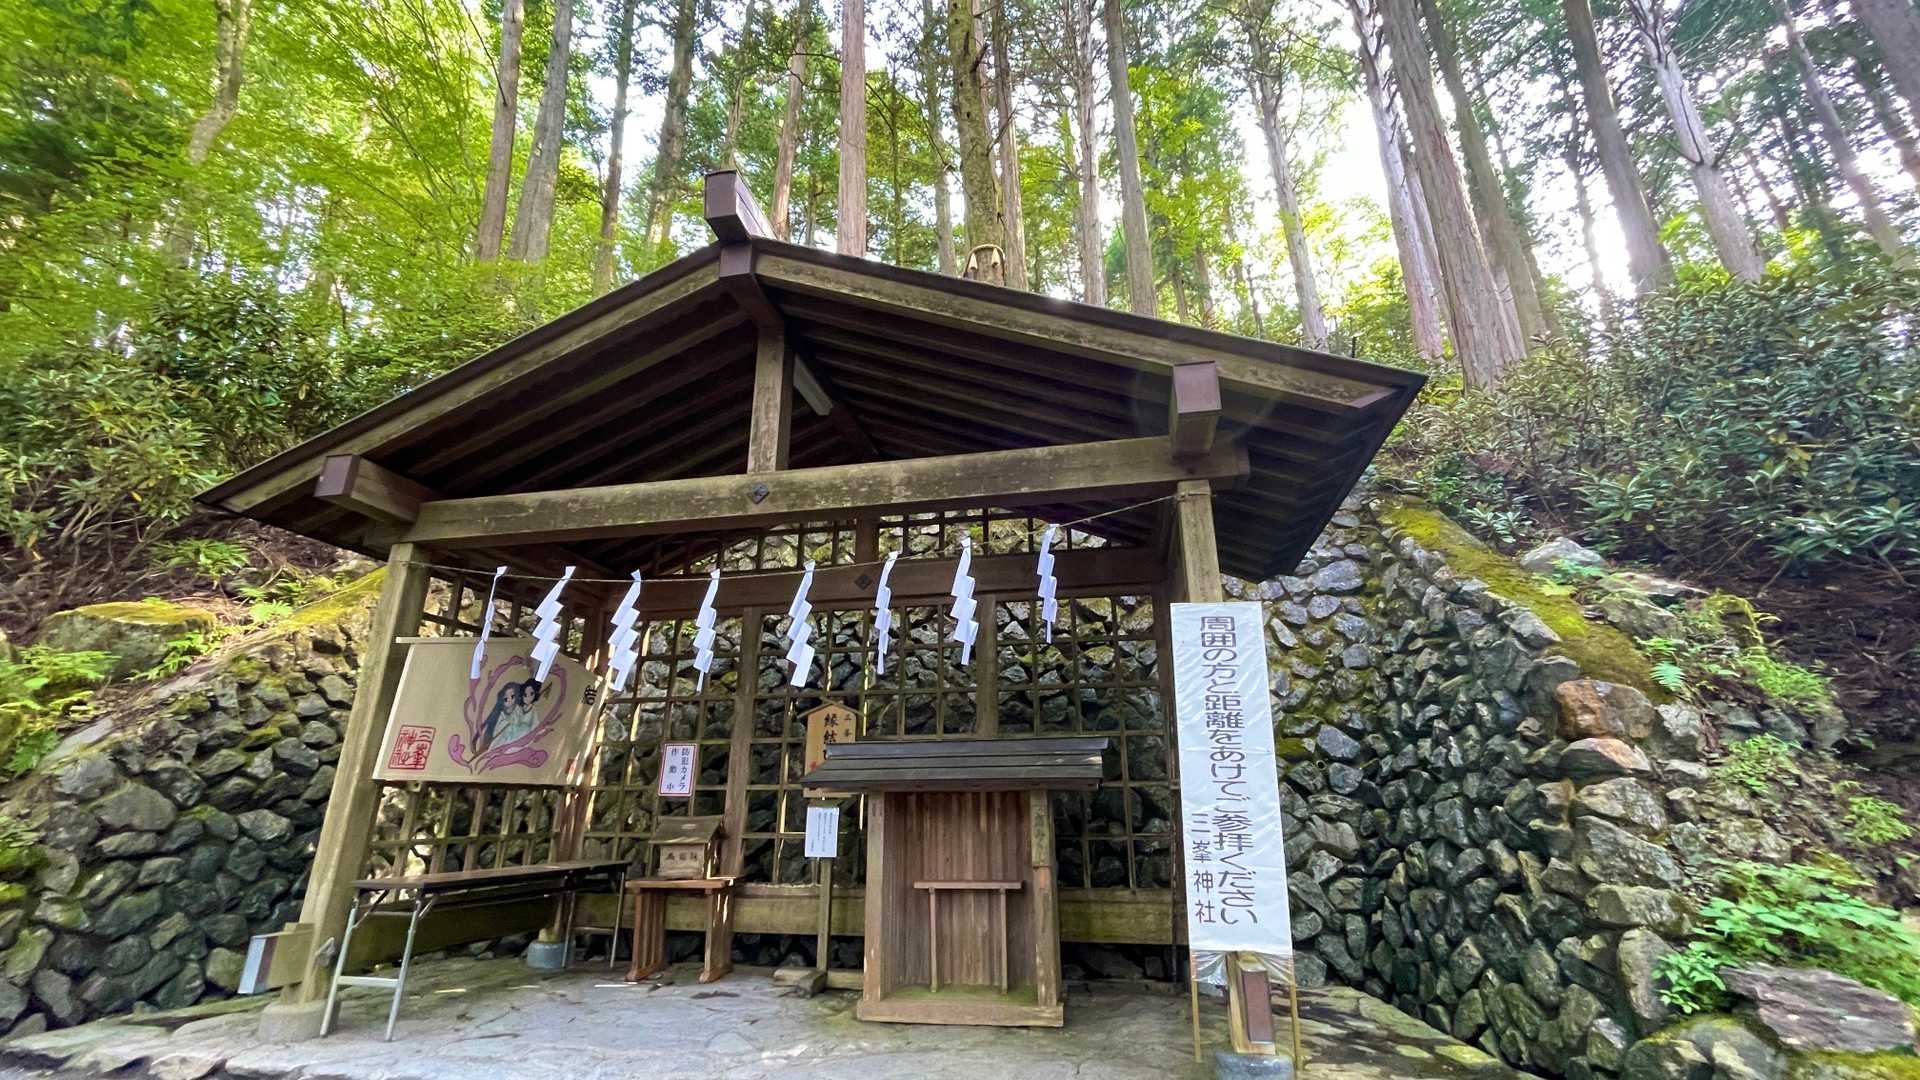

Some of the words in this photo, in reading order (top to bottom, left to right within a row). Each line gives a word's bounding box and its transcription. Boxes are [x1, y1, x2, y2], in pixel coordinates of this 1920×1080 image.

[679, 747, 690, 791] 防犯カメラ
[1200, 616, 1258, 925] 周囲の方と距離をあけてご参拝ください
[1191, 813, 1217, 924] 三峯神社
